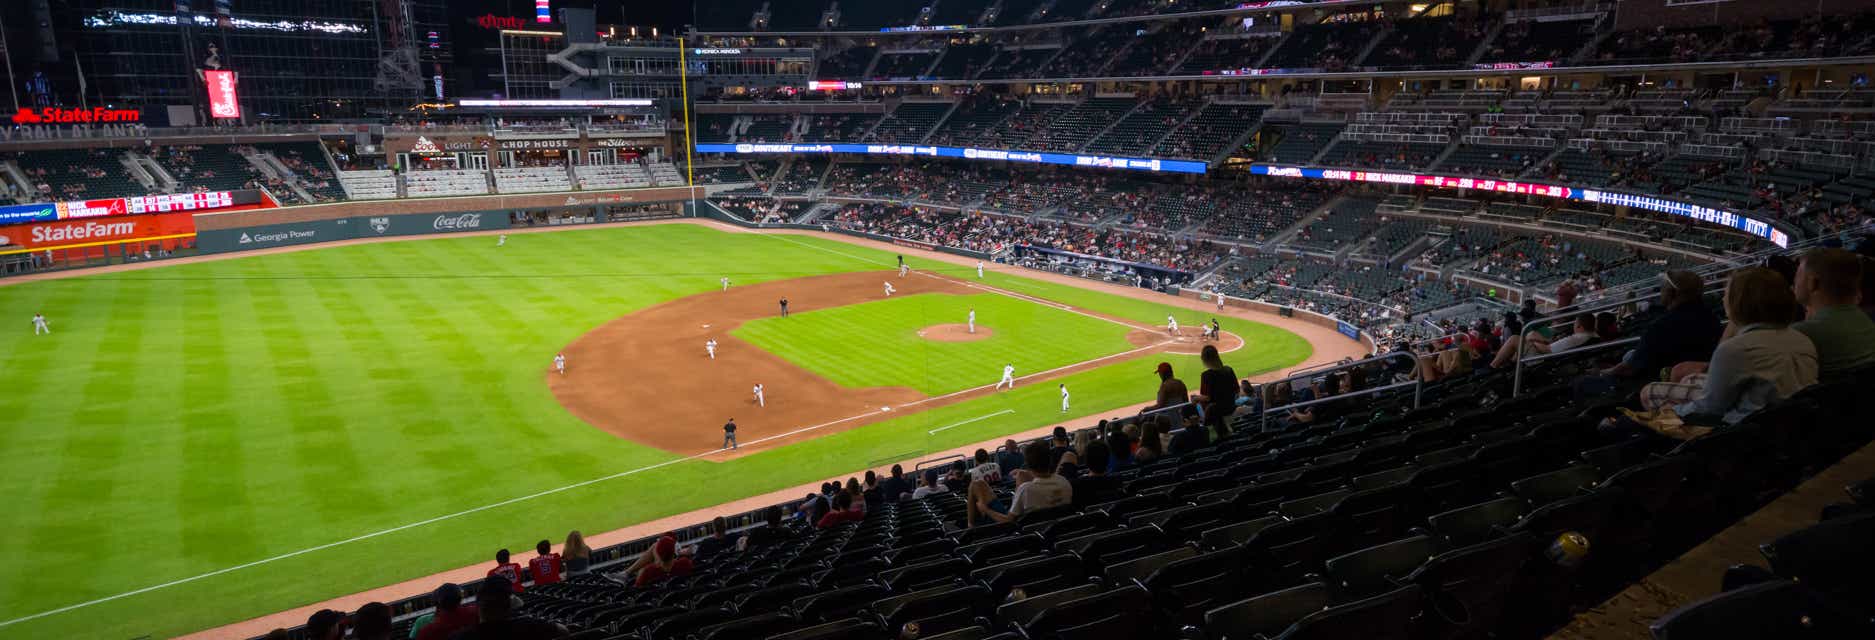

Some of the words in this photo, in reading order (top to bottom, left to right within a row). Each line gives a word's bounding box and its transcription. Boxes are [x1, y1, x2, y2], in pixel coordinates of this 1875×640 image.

[444, 142, 472, 150] LIGHT
[433, 213, 481, 230] Coca-Cola
[31, 222, 134, 243] StateFarm
[253, 233, 288, 242] Georgia
[290, 230, 315, 239] Power
